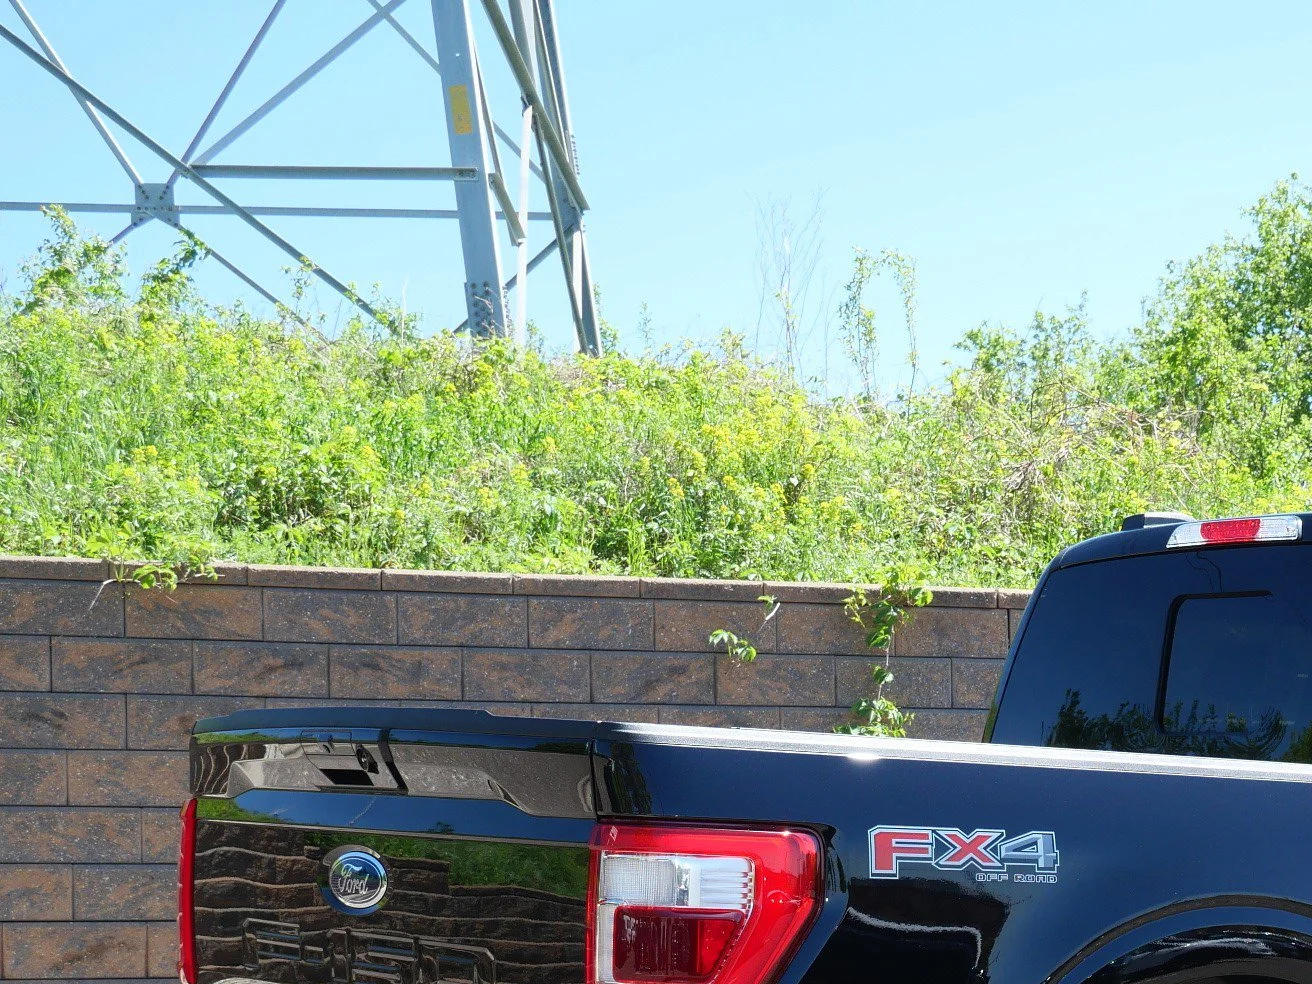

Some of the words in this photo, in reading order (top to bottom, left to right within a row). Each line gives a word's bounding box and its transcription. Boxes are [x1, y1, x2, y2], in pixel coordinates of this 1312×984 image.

[867, 825, 1060, 880] FX4
[337, 863, 369, 895] Ford
[975, 872, 1009, 883] OFF
[1013, 873, 1058, 884] ROAD
